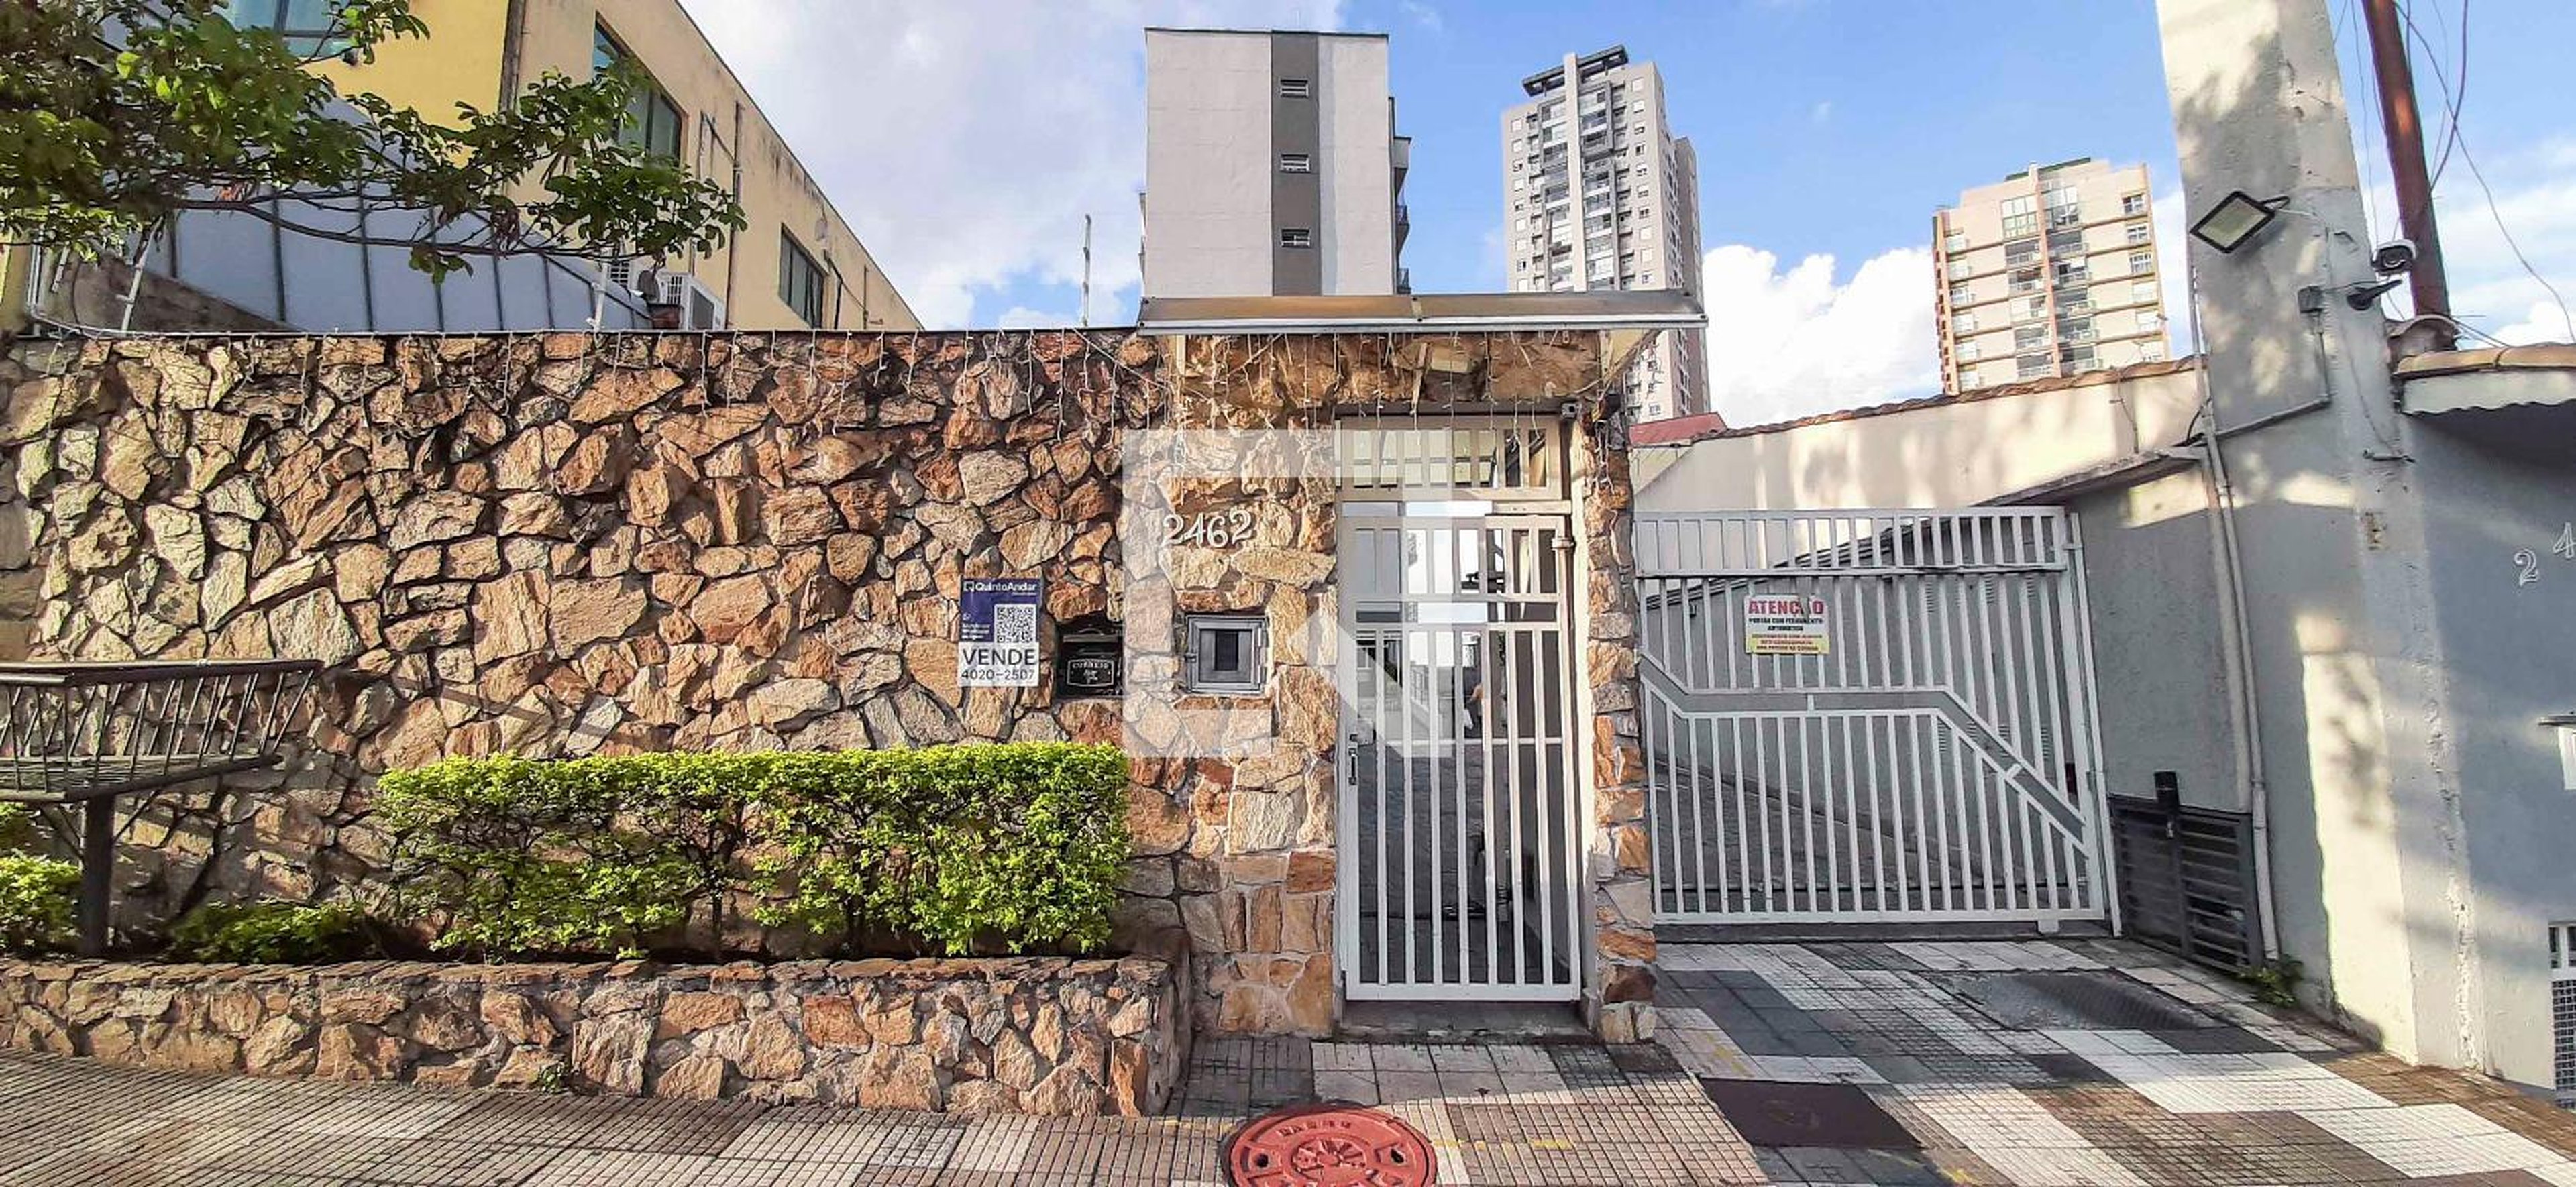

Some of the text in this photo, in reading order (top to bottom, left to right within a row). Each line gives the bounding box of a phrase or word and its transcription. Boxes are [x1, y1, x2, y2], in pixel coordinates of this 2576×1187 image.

[1160, 506, 1252, 547] 2462
[975, 582, 1037, 591] QuintoAndar
[1748, 600, 1824, 617] ATENÇO
[963, 648, 1036, 665] VENDE
[961, 669, 1034, 681] 4020-2507
